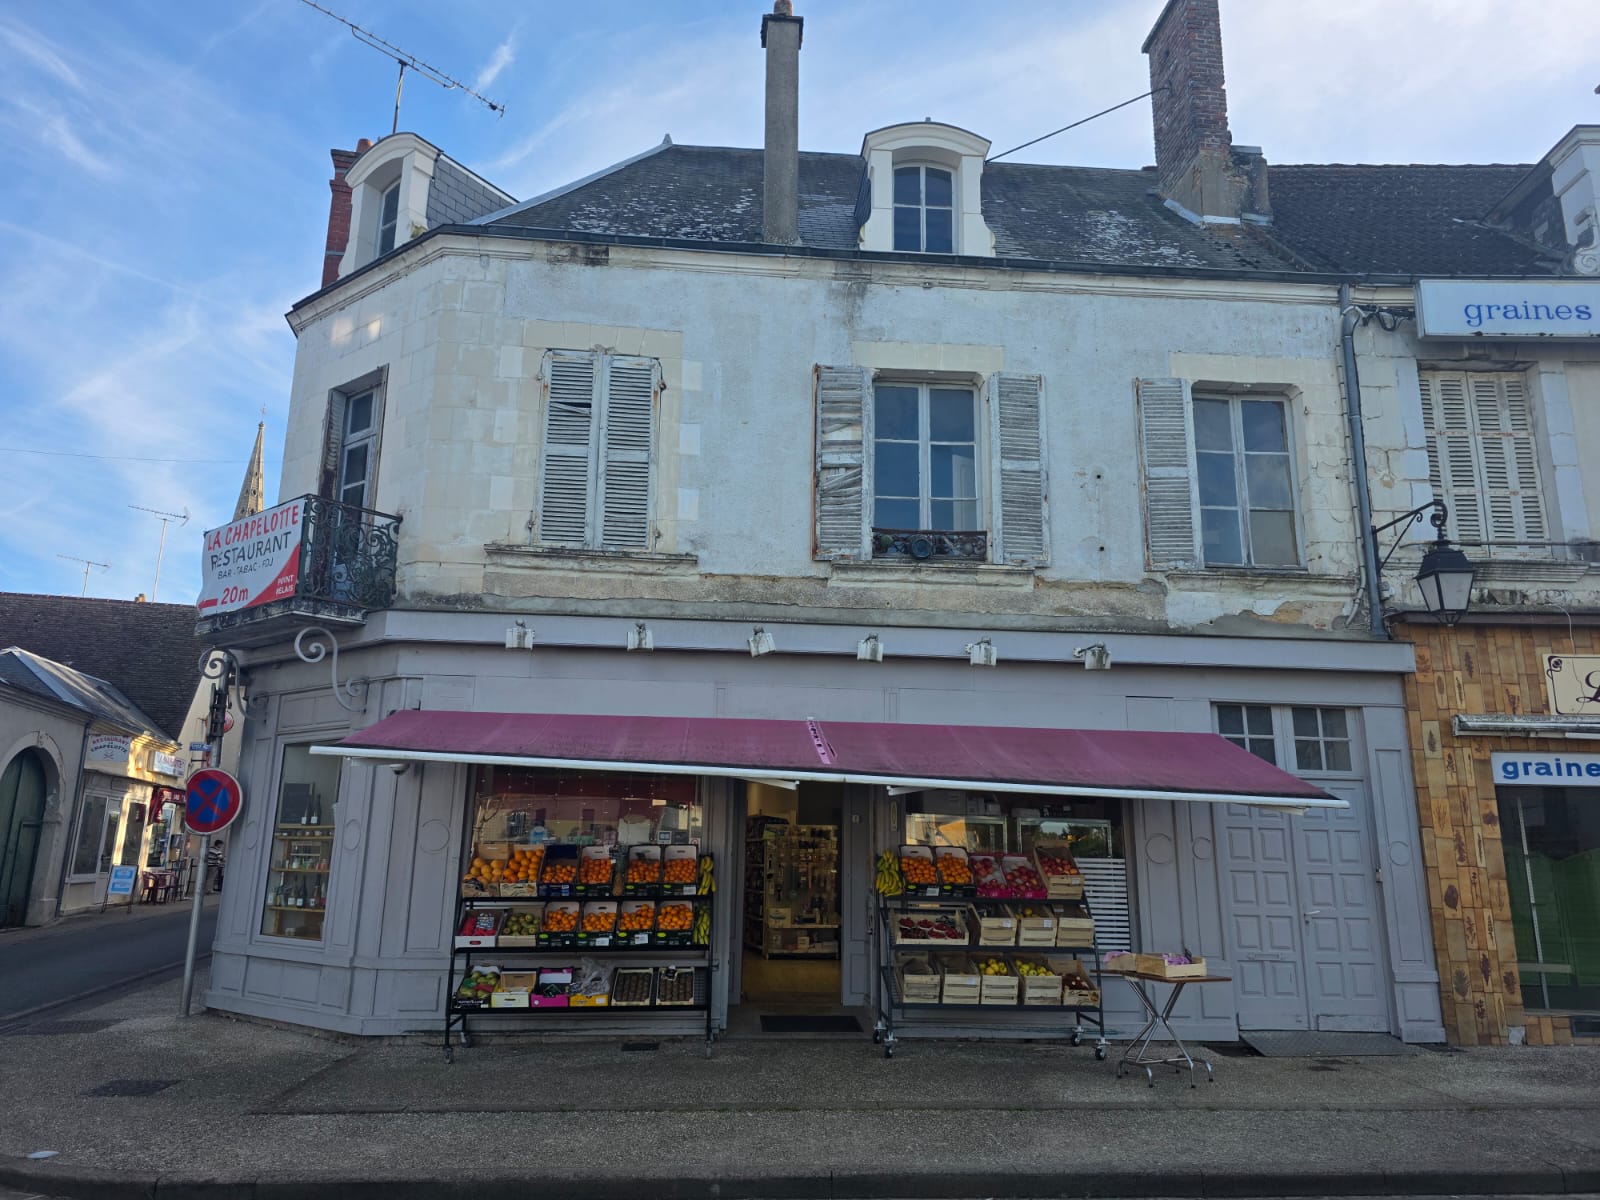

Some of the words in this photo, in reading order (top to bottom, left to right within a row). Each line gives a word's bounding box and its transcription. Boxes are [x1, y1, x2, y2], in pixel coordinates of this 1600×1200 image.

[1464, 300, 1592, 328] graines
[207, 530, 221, 552] LA
[225, 505, 299, 546] CHAPELOTTE
[210, 531, 291, 571] RESTAURANT
[217, 569, 232, 580] BAR
[237, 561, 257, 575] TABAC
[221, 586, 249, 605] 20m
[1502, 758, 1600, 780] graine
